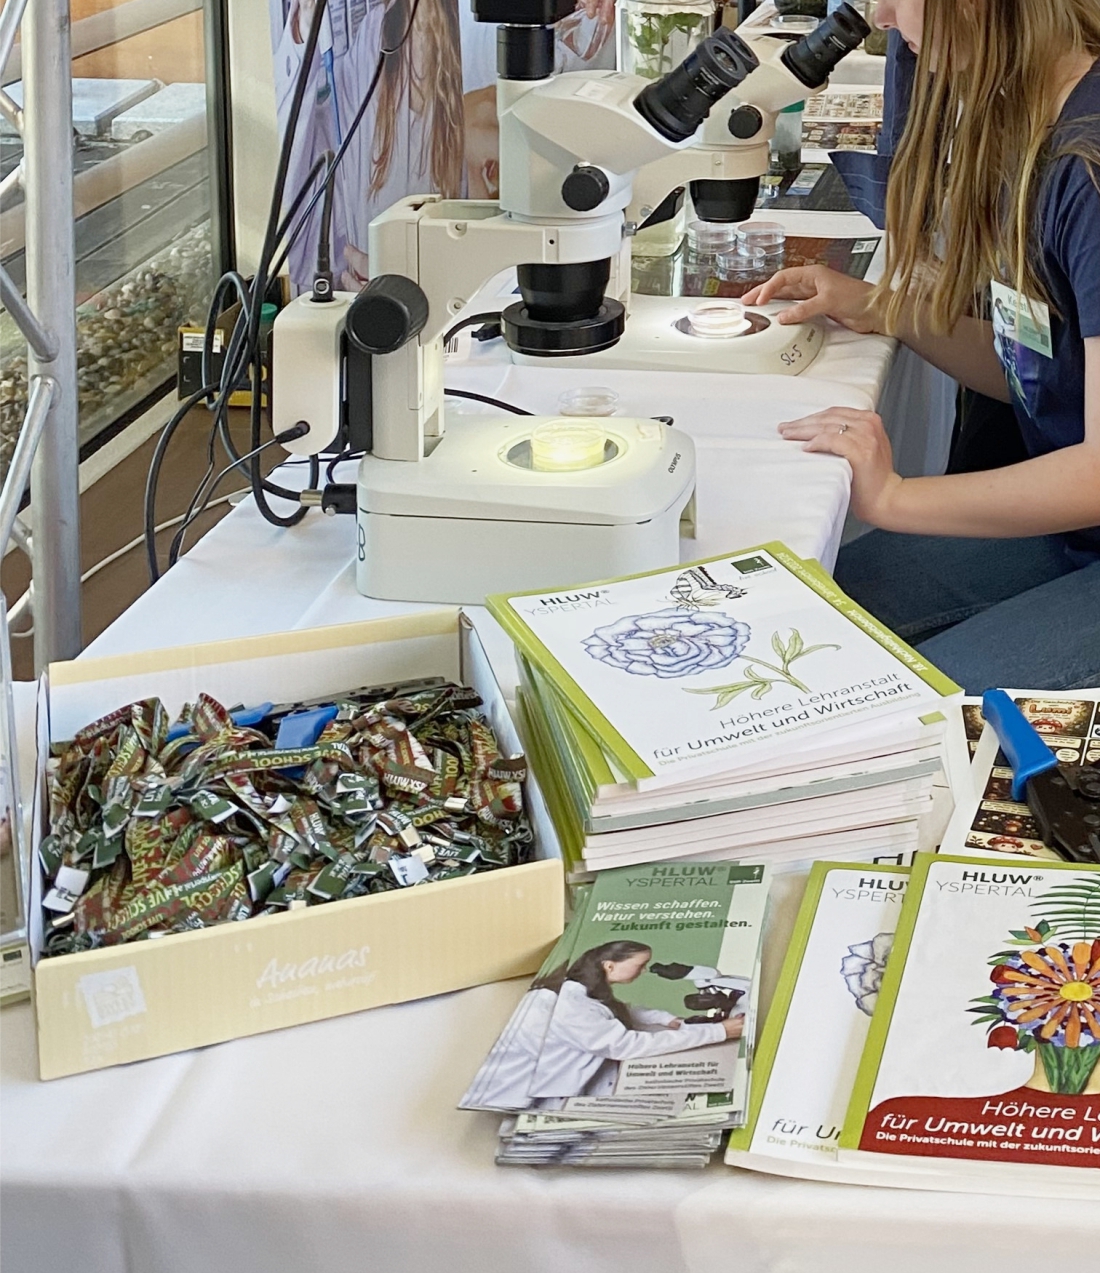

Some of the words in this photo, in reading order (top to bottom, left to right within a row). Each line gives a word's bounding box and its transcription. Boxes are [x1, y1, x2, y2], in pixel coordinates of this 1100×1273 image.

[523, 597, 616, 616] YSPERTAL
[719, 701, 794, 729] Höhere
[798, 672, 901, 706] Lehranstalt
[1028, 703, 1073, 715] Lumi
[653, 744, 682, 760] für
[686, 722, 767, 751] Umwelt
[771, 710, 811, 728] und
[813, 681, 913, 715] Wirtschaft
[250, 753, 312, 768] SCHOOL
[625, 876, 718, 887] YSPERTAL
[858, 878, 909, 891] HLU
[936, 880, 1037, 898] YSPERTAL
[596, 900, 649, 911] Wissen
[653, 898, 722, 910] schaffen.
[591, 911, 634, 922] Natur
[639, 909, 715, 921] verstehen.
[610, 920, 673, 932] Zukunft
[675, 918, 753, 932] gestalten.
[981, 1099, 1076, 1121] Höhere
[771, 1118, 809, 1136] für
[879, 1114, 918, 1132] für
[924, 1116, 1025, 1139] Umwelt
[1031, 1125, 1082, 1142] und
[766, 1135, 783, 1146] Die
[875, 1132, 897, 1142] Die
[899, 1133, 974, 1147] Privatschule
[977, 1138, 998, 1148] mit
[1000, 1140, 1021, 1151] der
